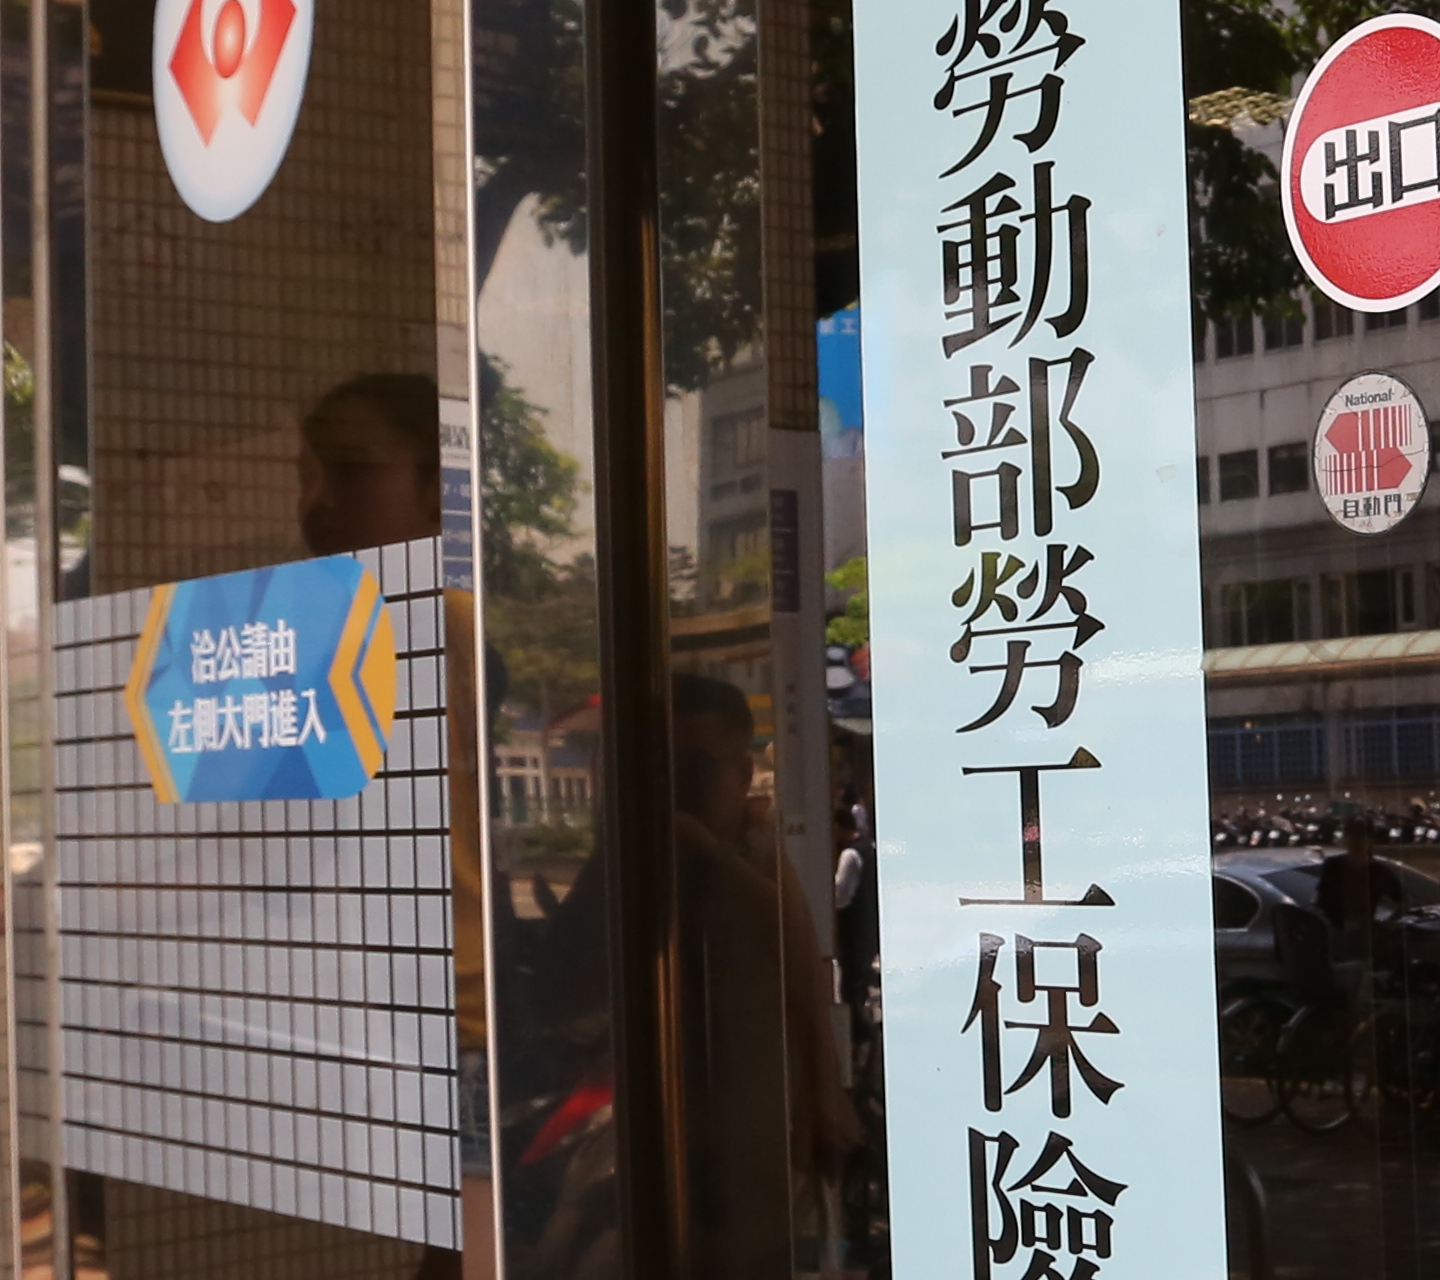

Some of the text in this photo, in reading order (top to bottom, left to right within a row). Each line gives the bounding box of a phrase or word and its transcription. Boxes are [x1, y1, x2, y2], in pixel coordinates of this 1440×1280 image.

[1344, 387, 1394, 408] National
[1343, 492, 1403, 519] 自動門
[190, 619, 296, 684] 洽公請由
[167, 688, 327, 754] 左側大門進入
